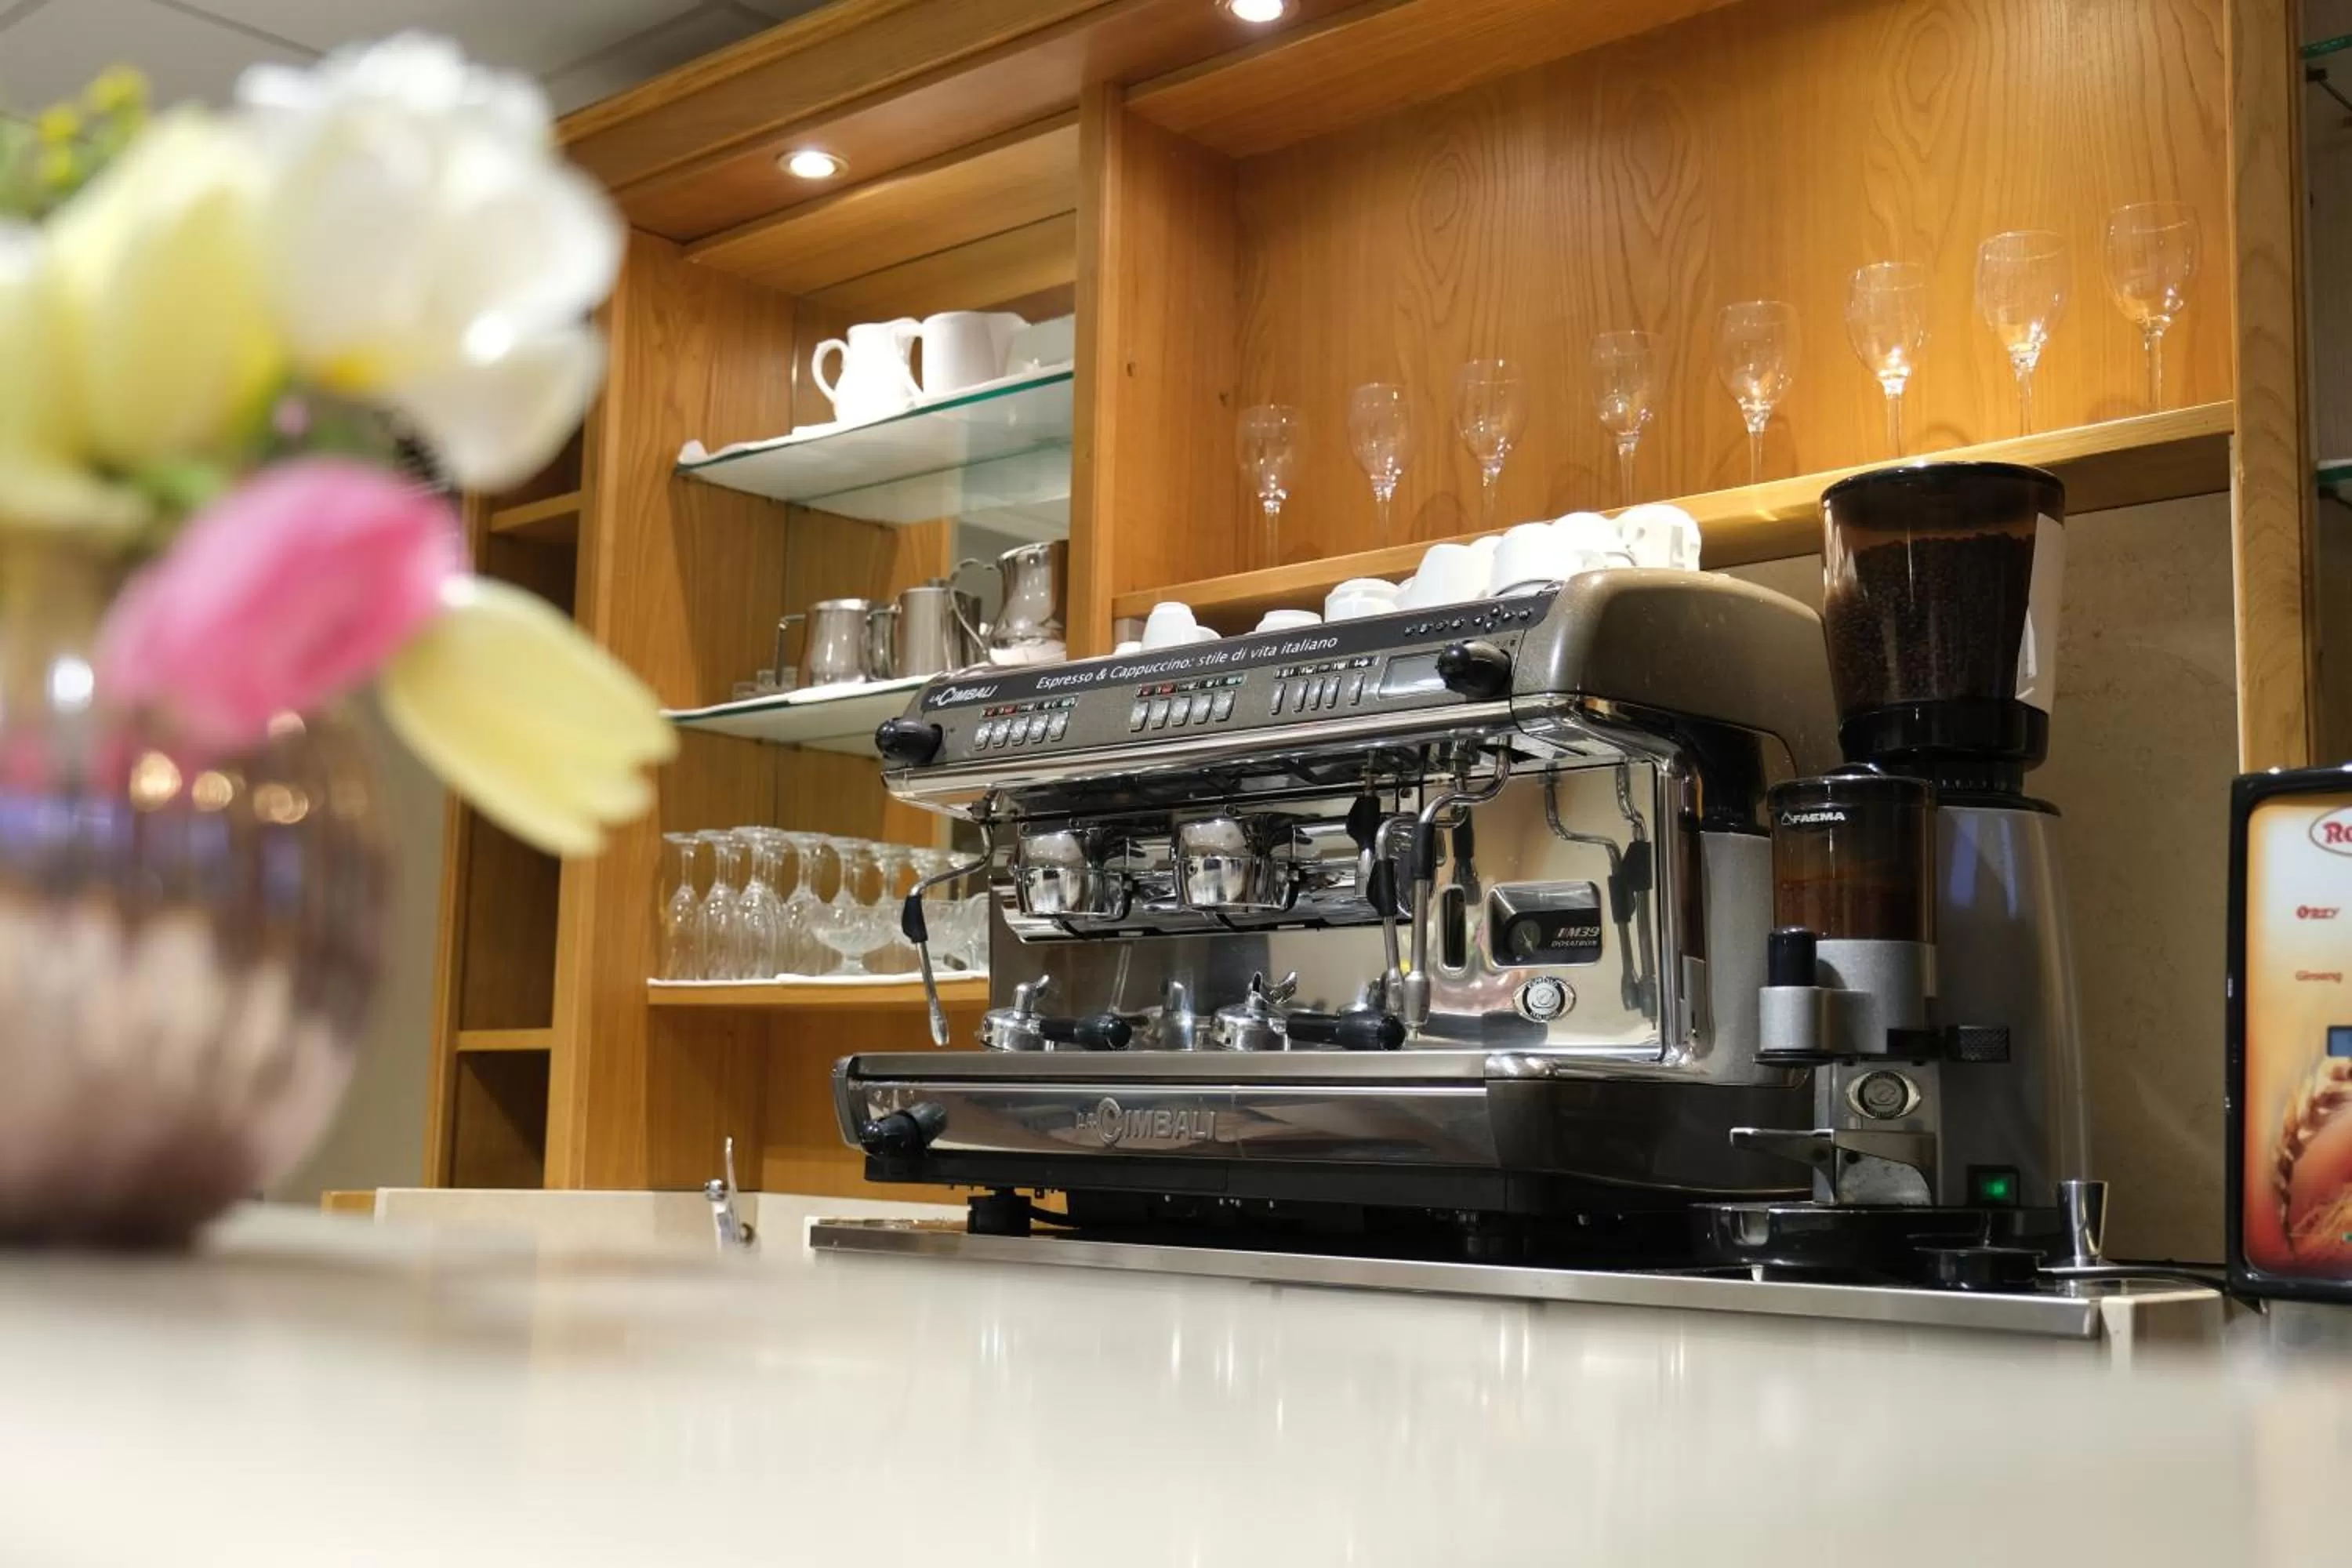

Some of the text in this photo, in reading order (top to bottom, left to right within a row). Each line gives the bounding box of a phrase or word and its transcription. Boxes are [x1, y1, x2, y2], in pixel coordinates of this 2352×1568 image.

[1036, 637, 1338, 690] Espresso & Cappuccino: stile di vita italiano
[1792, 811, 1846, 824] FAEMA
[1098, 1097, 1215, 1145] CIMBALI
